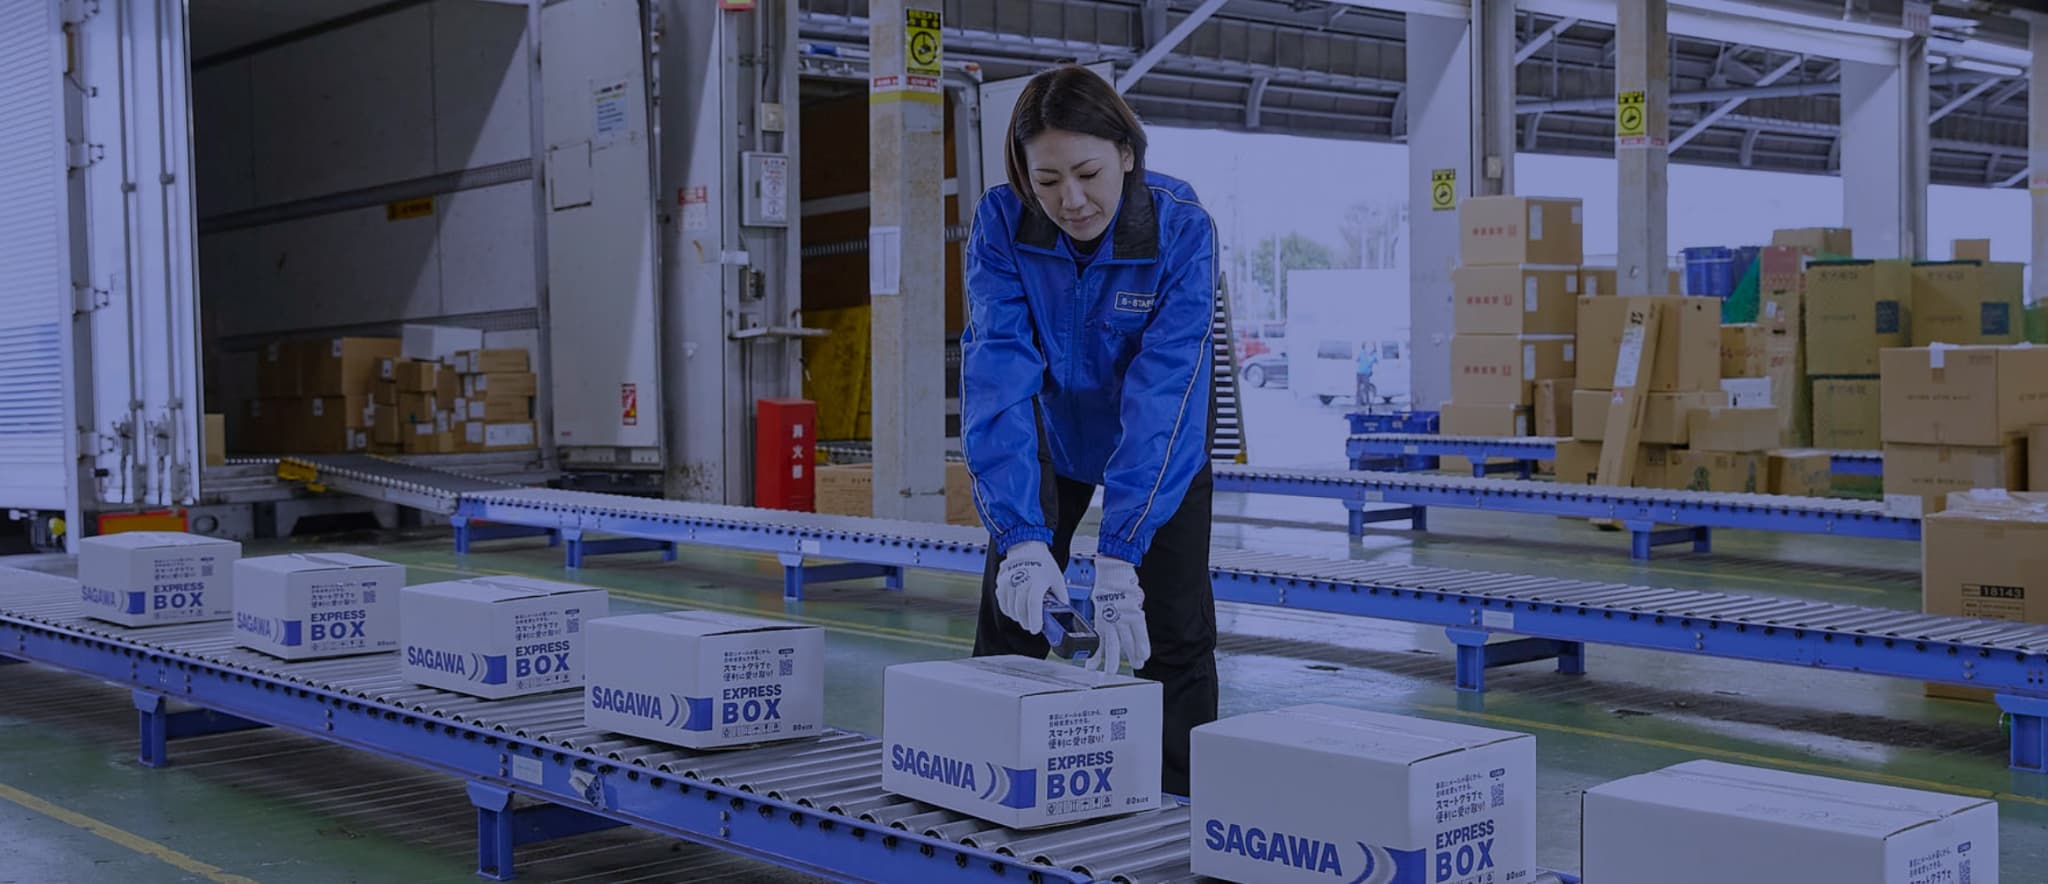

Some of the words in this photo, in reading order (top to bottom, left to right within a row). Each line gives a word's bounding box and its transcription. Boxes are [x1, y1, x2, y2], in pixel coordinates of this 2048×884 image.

[154, 582, 205, 594] EXPRESS
[154, 592, 203, 610] BOX
[1983, 586, 2022, 598] 18143
[311, 609, 366, 623] EXPRESS
[311, 620, 365, 641] BOX
[408, 645, 466, 676] SAGAWA
[516, 640, 570, 657] EXPRESS
[516, 652, 570, 678] BOX
[592, 686, 663, 721] SAGAWA
[723, 684, 782, 701] EXPRESS
[722, 698, 781, 725] BOX
[892, 743, 977, 792] SAGAWA
[1047, 750, 1115, 771] EXPRESS
[1047, 766, 1113, 801] BOX
[1436, 819, 1495, 850] EXPRESS
[1205, 819, 1343, 877] SAGAWA
[1436, 838, 1495, 883] BOX
